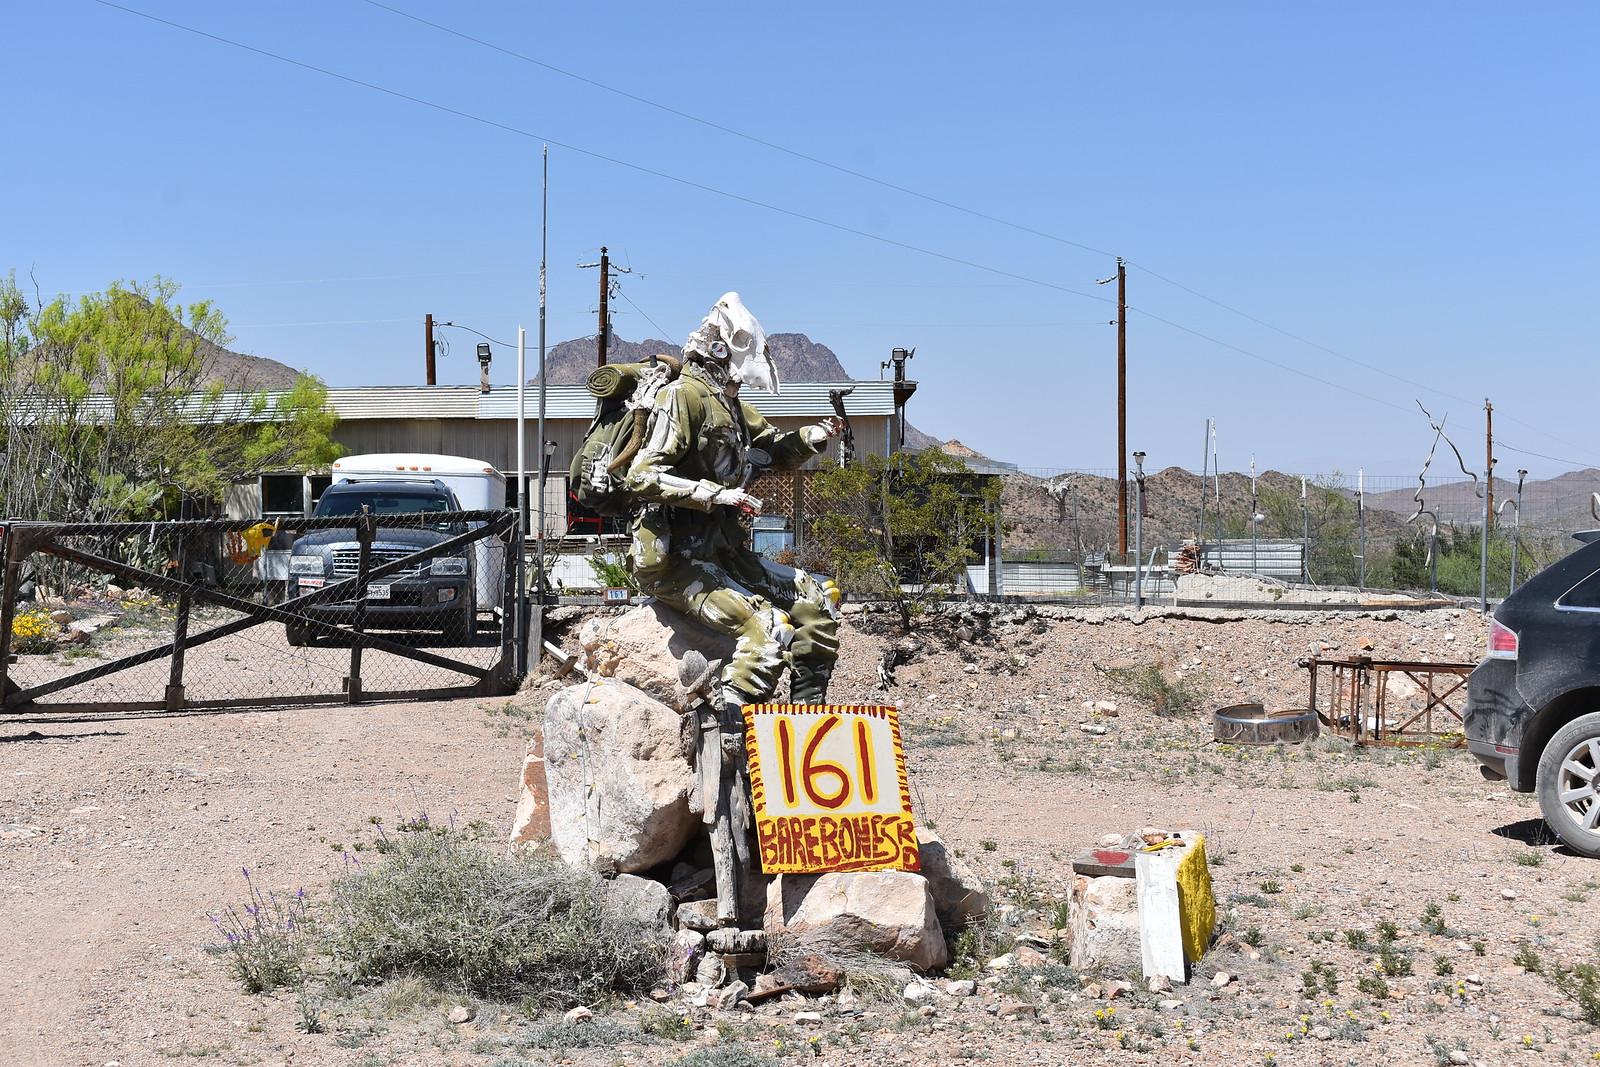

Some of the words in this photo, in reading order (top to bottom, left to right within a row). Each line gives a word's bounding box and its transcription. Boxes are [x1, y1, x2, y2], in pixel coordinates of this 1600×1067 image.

[610, 590, 623, 599] 161
[778, 716, 875, 809] 161
[897, 821, 921, 872] RD
